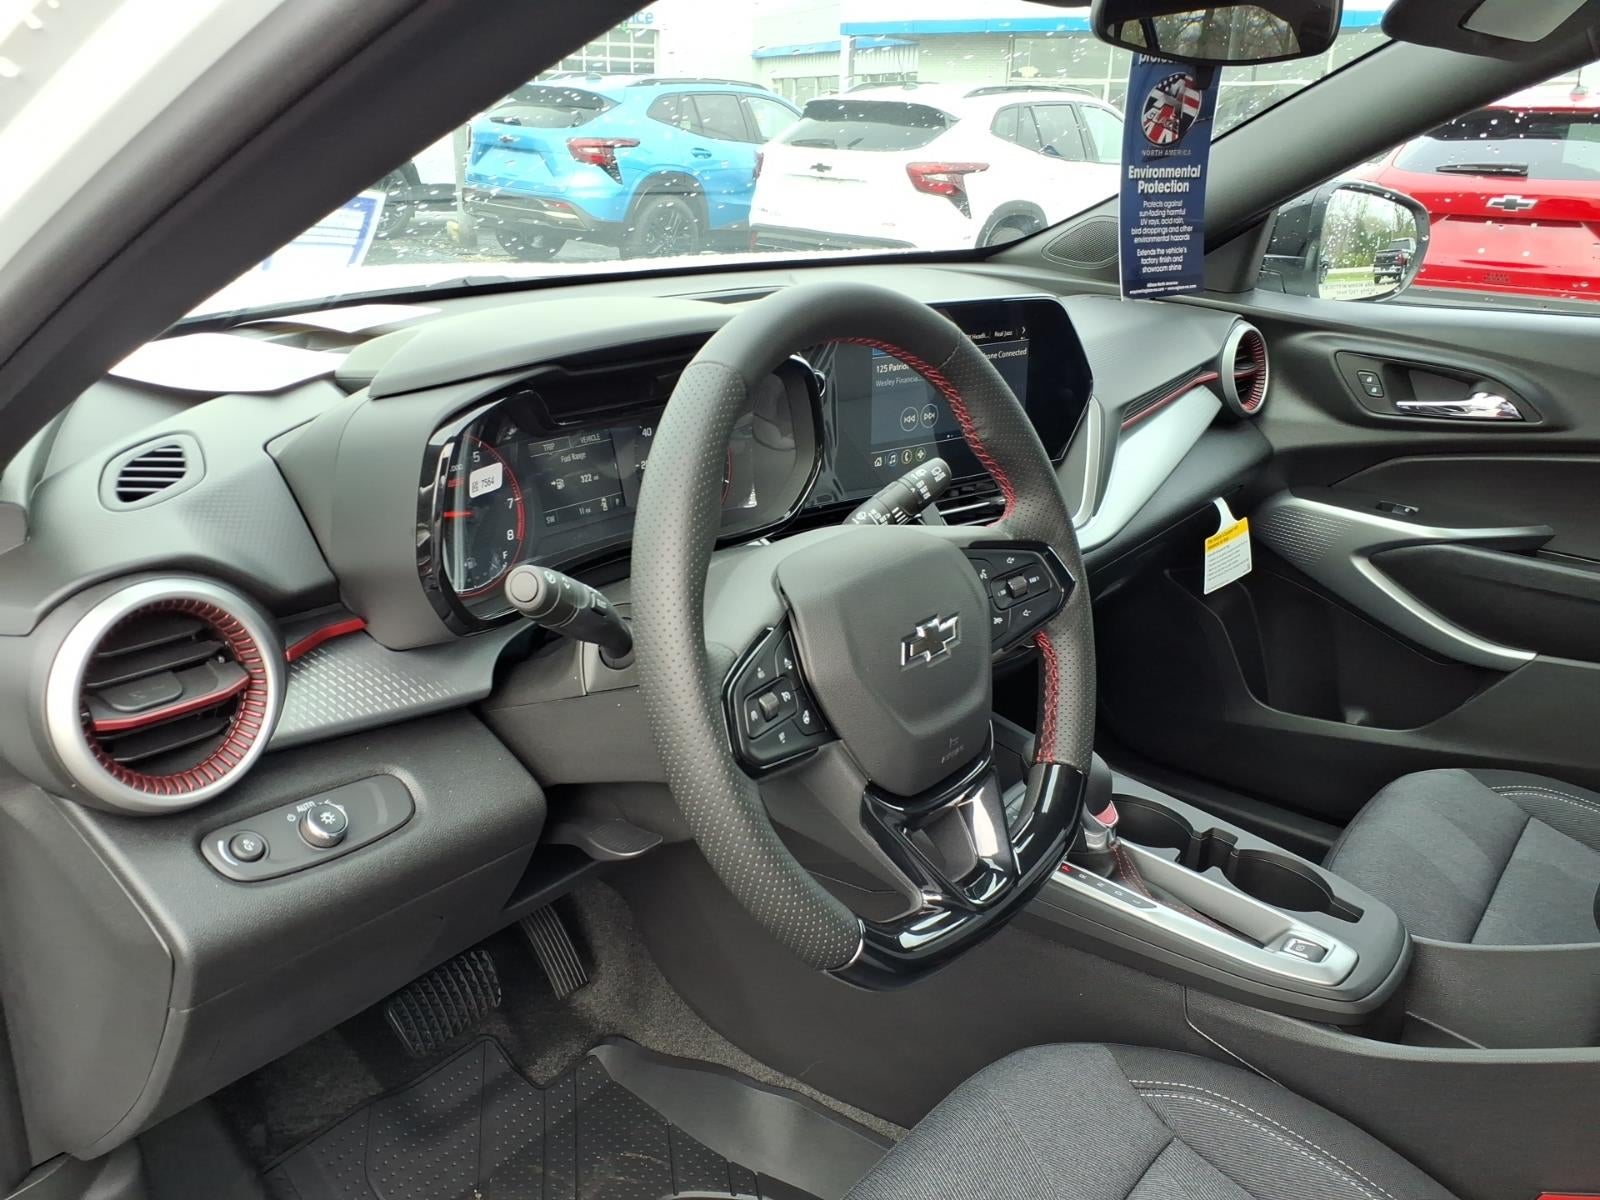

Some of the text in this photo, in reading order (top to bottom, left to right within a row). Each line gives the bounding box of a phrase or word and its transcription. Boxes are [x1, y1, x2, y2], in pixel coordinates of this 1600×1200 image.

[1128, 164, 1201, 179] Environmental
[1137, 180, 1190, 194] Protection
[1143, 199, 1183, 208] Protects against
[1166, 208, 1186, 216] harmful
[1140, 218, 1148, 226] UV
[1160, 217, 1173, 225] acid
[1130, 227, 1142, 235] bird
[1142, 226, 1168, 235] droppings
[1180, 225, 1193, 233] other
[1134, 234, 1170, 243] environmental
[1136, 248, 1156, 257] Extends
[1156, 247, 1165, 255] the
[1141, 254, 1183, 265] factory finish and
[1142, 263, 1182, 273] showroom shine
[998, 347, 1028, 359] Connected
[876, 362, 909, 373] 125 Patrio
[875, 379, 895, 388] Wesley
[641, 427, 652, 437] 40
[580, 433, 601, 443] VEHICLE
[472, 451, 481, 463] 5
[560, 452, 587, 463] Fuel Range
[506, 497, 514, 509] 7
[506, 529, 515, 541] 8
[502, 550, 509, 560] F
